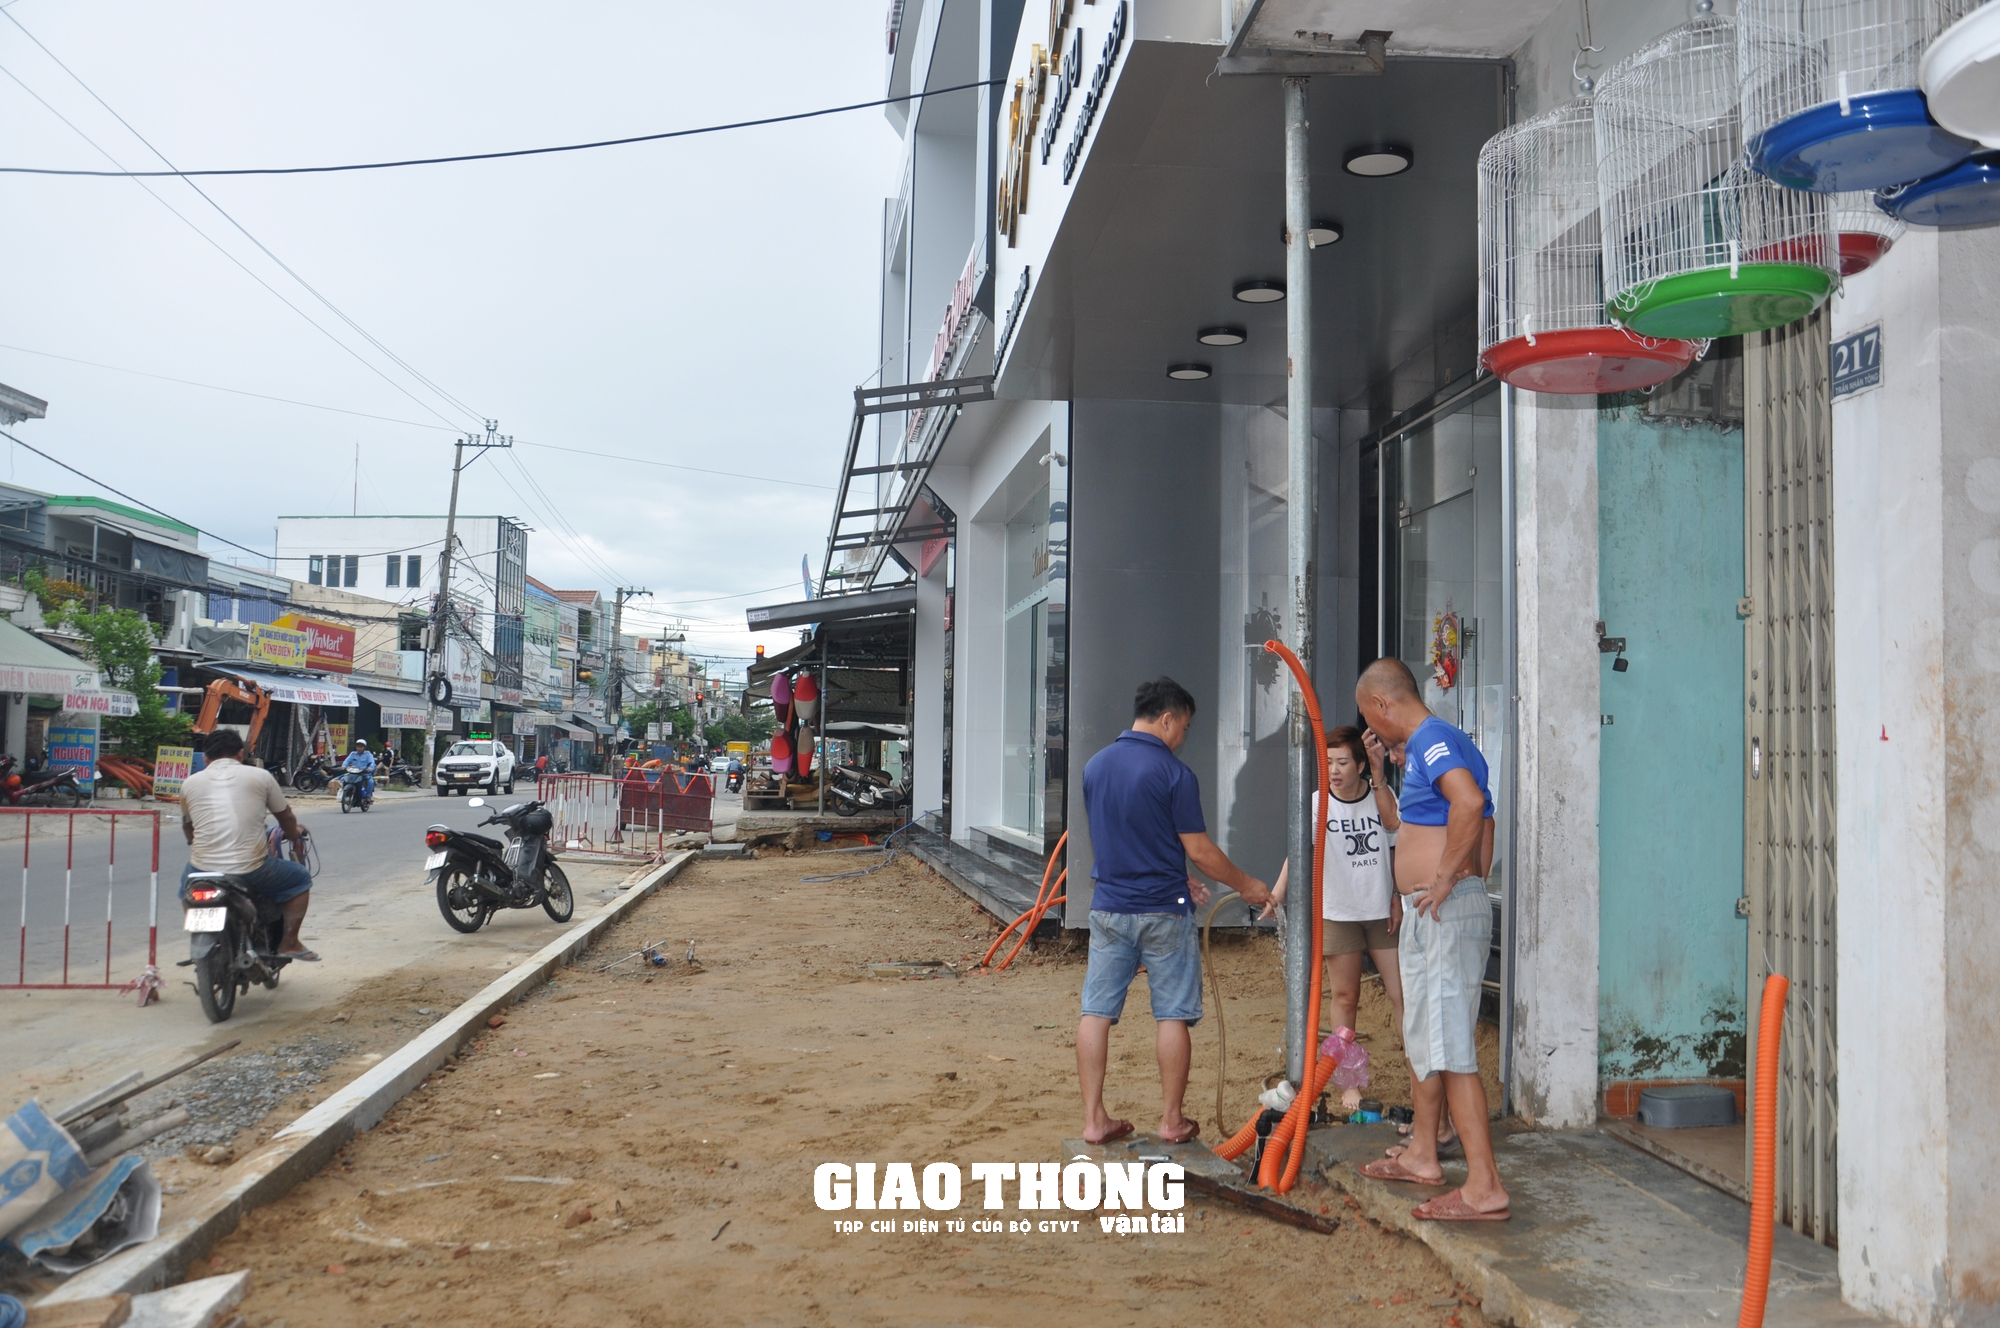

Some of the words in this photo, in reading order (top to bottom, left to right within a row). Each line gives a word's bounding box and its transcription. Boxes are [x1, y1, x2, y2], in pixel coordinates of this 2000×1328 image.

[1835, 331, 1878, 379] 217
[90, 695, 110, 712] NGA
[174, 762, 189, 779] NGA
[1326, 814, 1383, 833] CELIN
[1351, 858, 1378, 869] PARIS
